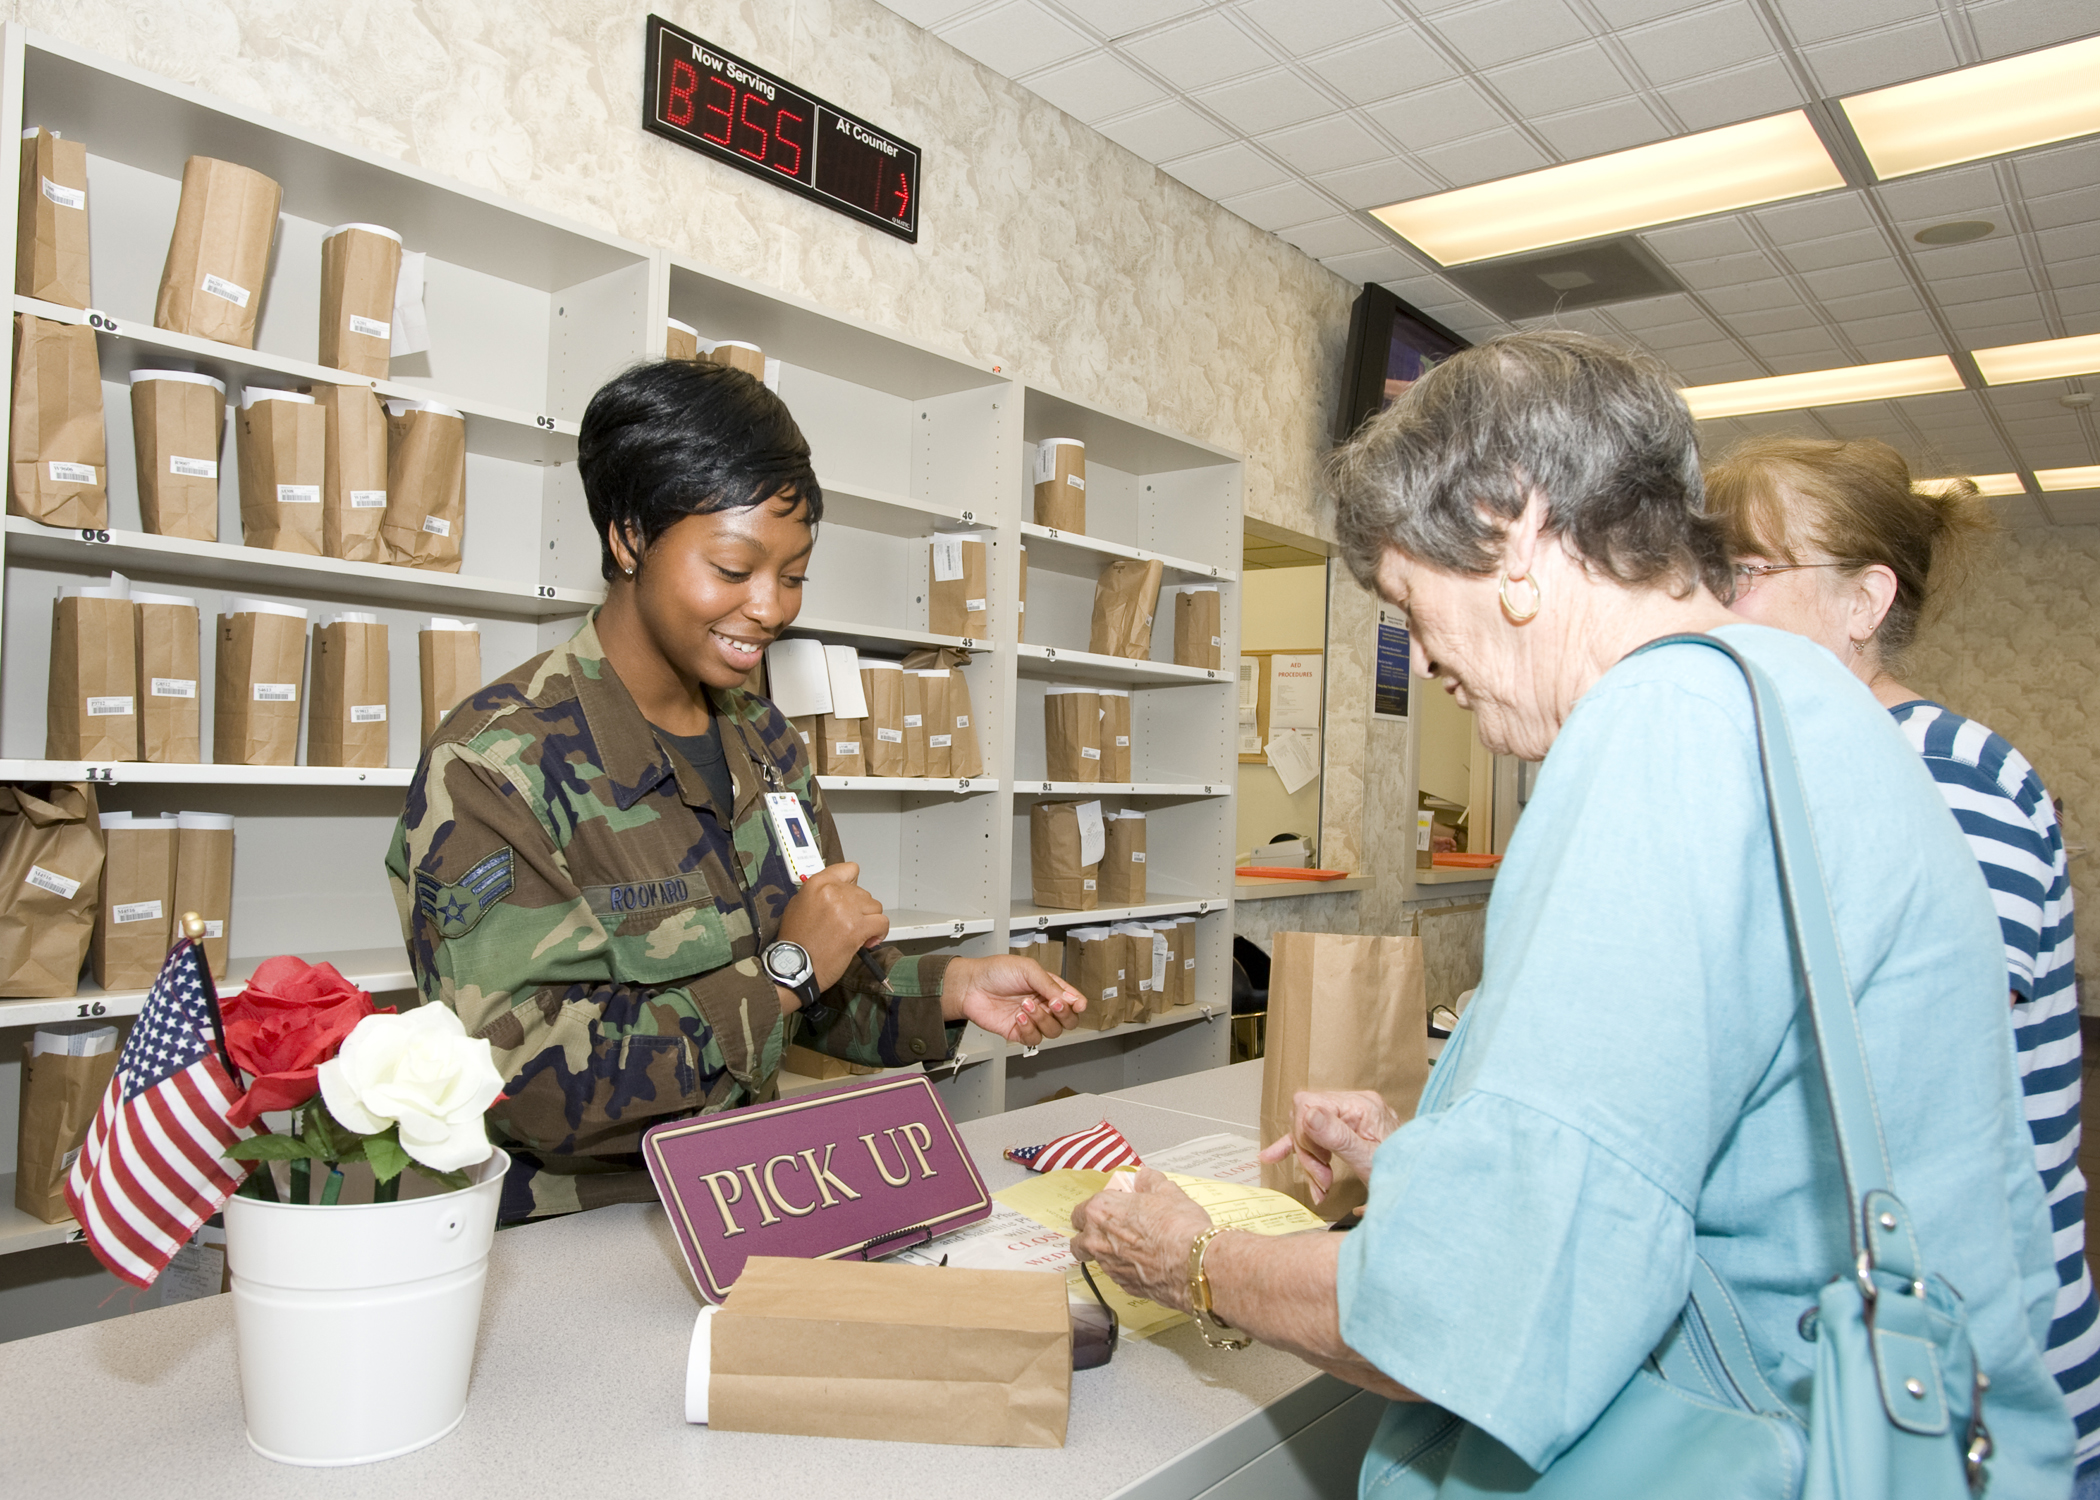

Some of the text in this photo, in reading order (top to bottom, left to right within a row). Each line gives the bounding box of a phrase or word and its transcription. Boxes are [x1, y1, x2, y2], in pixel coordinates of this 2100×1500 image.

[692, 45, 775, 101] Now Serving
[667, 58, 803, 175] B355
[836, 118, 899, 158] At Counter
[537, 415, 555, 430] 05
[962, 511, 973, 520] 40
[82, 528, 110, 543] 06
[1048, 528, 1058, 538] 71
[538, 586, 555, 598] 10
[962, 638, 973, 647] 45
[1046, 648, 1056, 657] 76
[1207, 670, 1215, 678] 80
[86, 768, 113, 781] 11
[959, 779, 970, 788] 50
[1042, 783, 1052, 791] 81
[1204, 785, 1212, 794] 85
[611, 879, 688, 911] ROOKARD
[1038, 916, 1049, 925] 86
[954, 923, 965, 933] 55
[77, 1001, 106, 1017] 16
[699, 1122, 938, 1239] PICK UP
[940, 1234, 965, 1246] and
[963, 1222, 1017, 1238] Satellite
[1004, 1227, 1031, 1237] will
